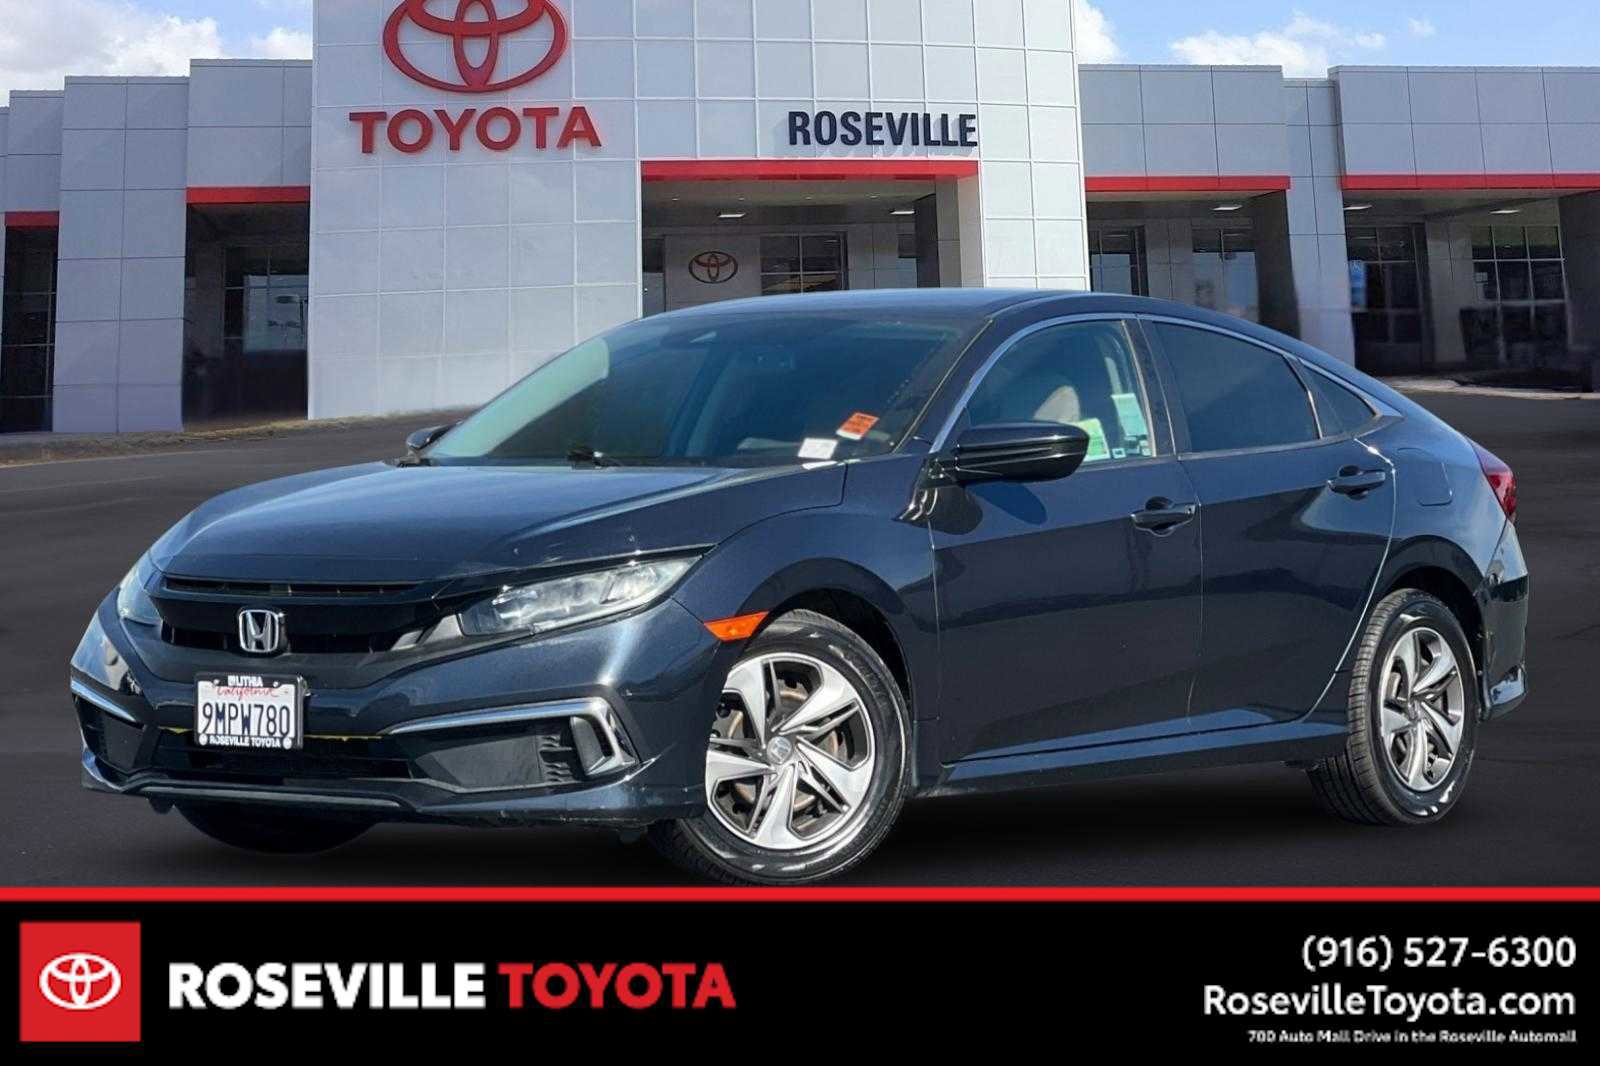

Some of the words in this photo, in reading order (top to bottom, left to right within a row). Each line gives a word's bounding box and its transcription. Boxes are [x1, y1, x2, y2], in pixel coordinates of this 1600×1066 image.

[349, 106, 602, 154] TOYOTA
[788, 110, 978, 147] ROSEVILLE
[202, 702, 290, 737] 9MPW780
[209, 735, 250, 746] ROSEVILLE
[251, 737, 281, 748] TOYOTA
